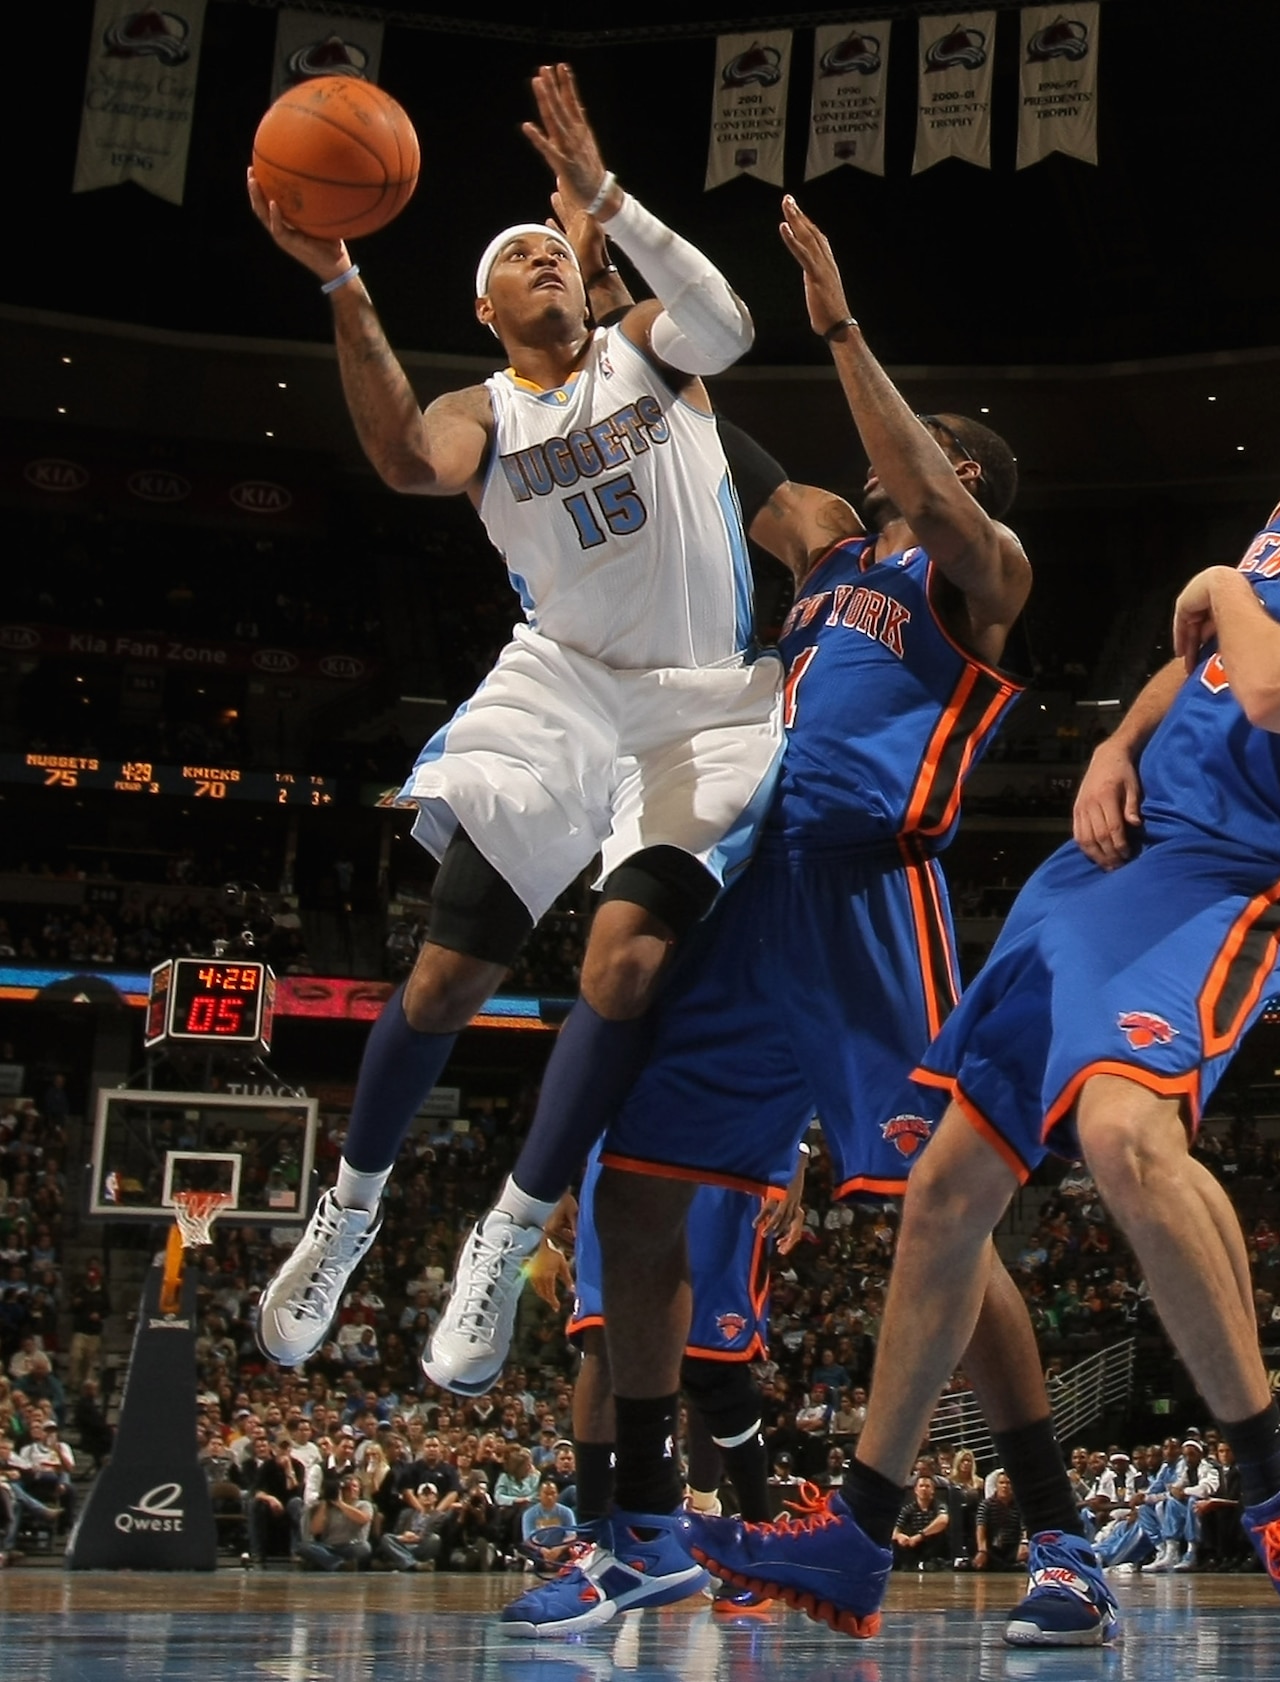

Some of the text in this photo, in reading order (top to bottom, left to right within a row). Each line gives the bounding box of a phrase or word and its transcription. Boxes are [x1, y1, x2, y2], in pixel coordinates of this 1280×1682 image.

[737, 95, 763, 105] 2001
[820, 96, 877, 109] WESTERN
[932, 90, 975, 102] 2000-01
[722, 107, 777, 118] WESTERN
[813, 109, 882, 122] CONFERENCE
[1036, 106, 1080, 119] TROPHY
[714, 119, 783, 130] CONFERENCE
[815, 122, 880, 135] CHAMPIONS
[930, 117, 974, 129] TROPHY
[717, 131, 780, 143] CHAMPIONS
[500, 395, 671, 503] NUGGETS
[36, 464, 79, 486] KIA
[138, 475, 182, 497] KIA
[241, 488, 282, 507] KIA
[562, 471, 648, 551] 15
[779, 584, 911, 660] EW YORK
[69, 633, 227, 665] Kia Fan Zone
[254, 651, 291, 668] KIA
[324, 658, 358, 676] KIA
[26, 754, 99, 771] NUGGETS
[44, 768, 78, 788] 75
[122, 762, 153, 782] 4:29
[182, 766, 241, 782] KNICKS
[193, 780, 226, 799] 70
[278, 787, 288, 804] 2
[198, 967, 257, 992] 4:29
[186, 995, 244, 1033] 05
[226, 1082, 309, 1099] TUACA
[115, 1503, 183, 1534] Qwest
[1040, 1569, 1077, 1584] NIKE
